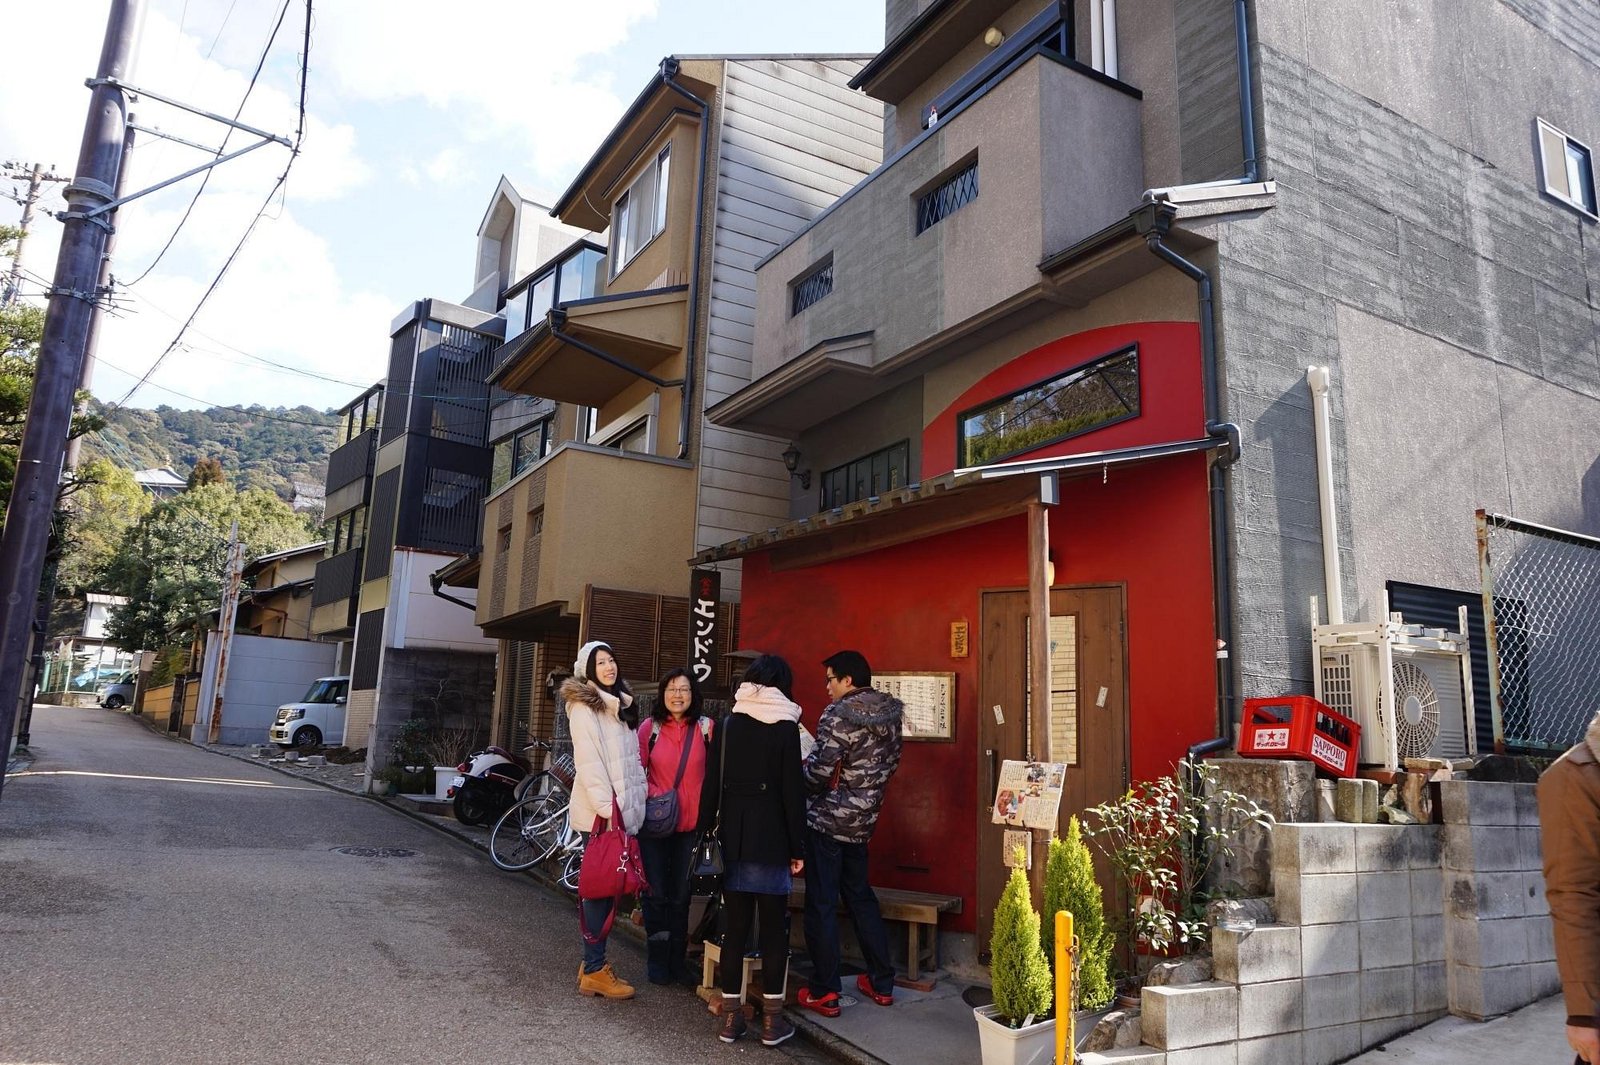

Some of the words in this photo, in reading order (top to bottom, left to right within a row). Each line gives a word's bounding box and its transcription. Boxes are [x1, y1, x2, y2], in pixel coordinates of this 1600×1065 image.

[693, 598, 715, 683] エンドウ
[1314, 736, 1345, 762] SAPPORO
